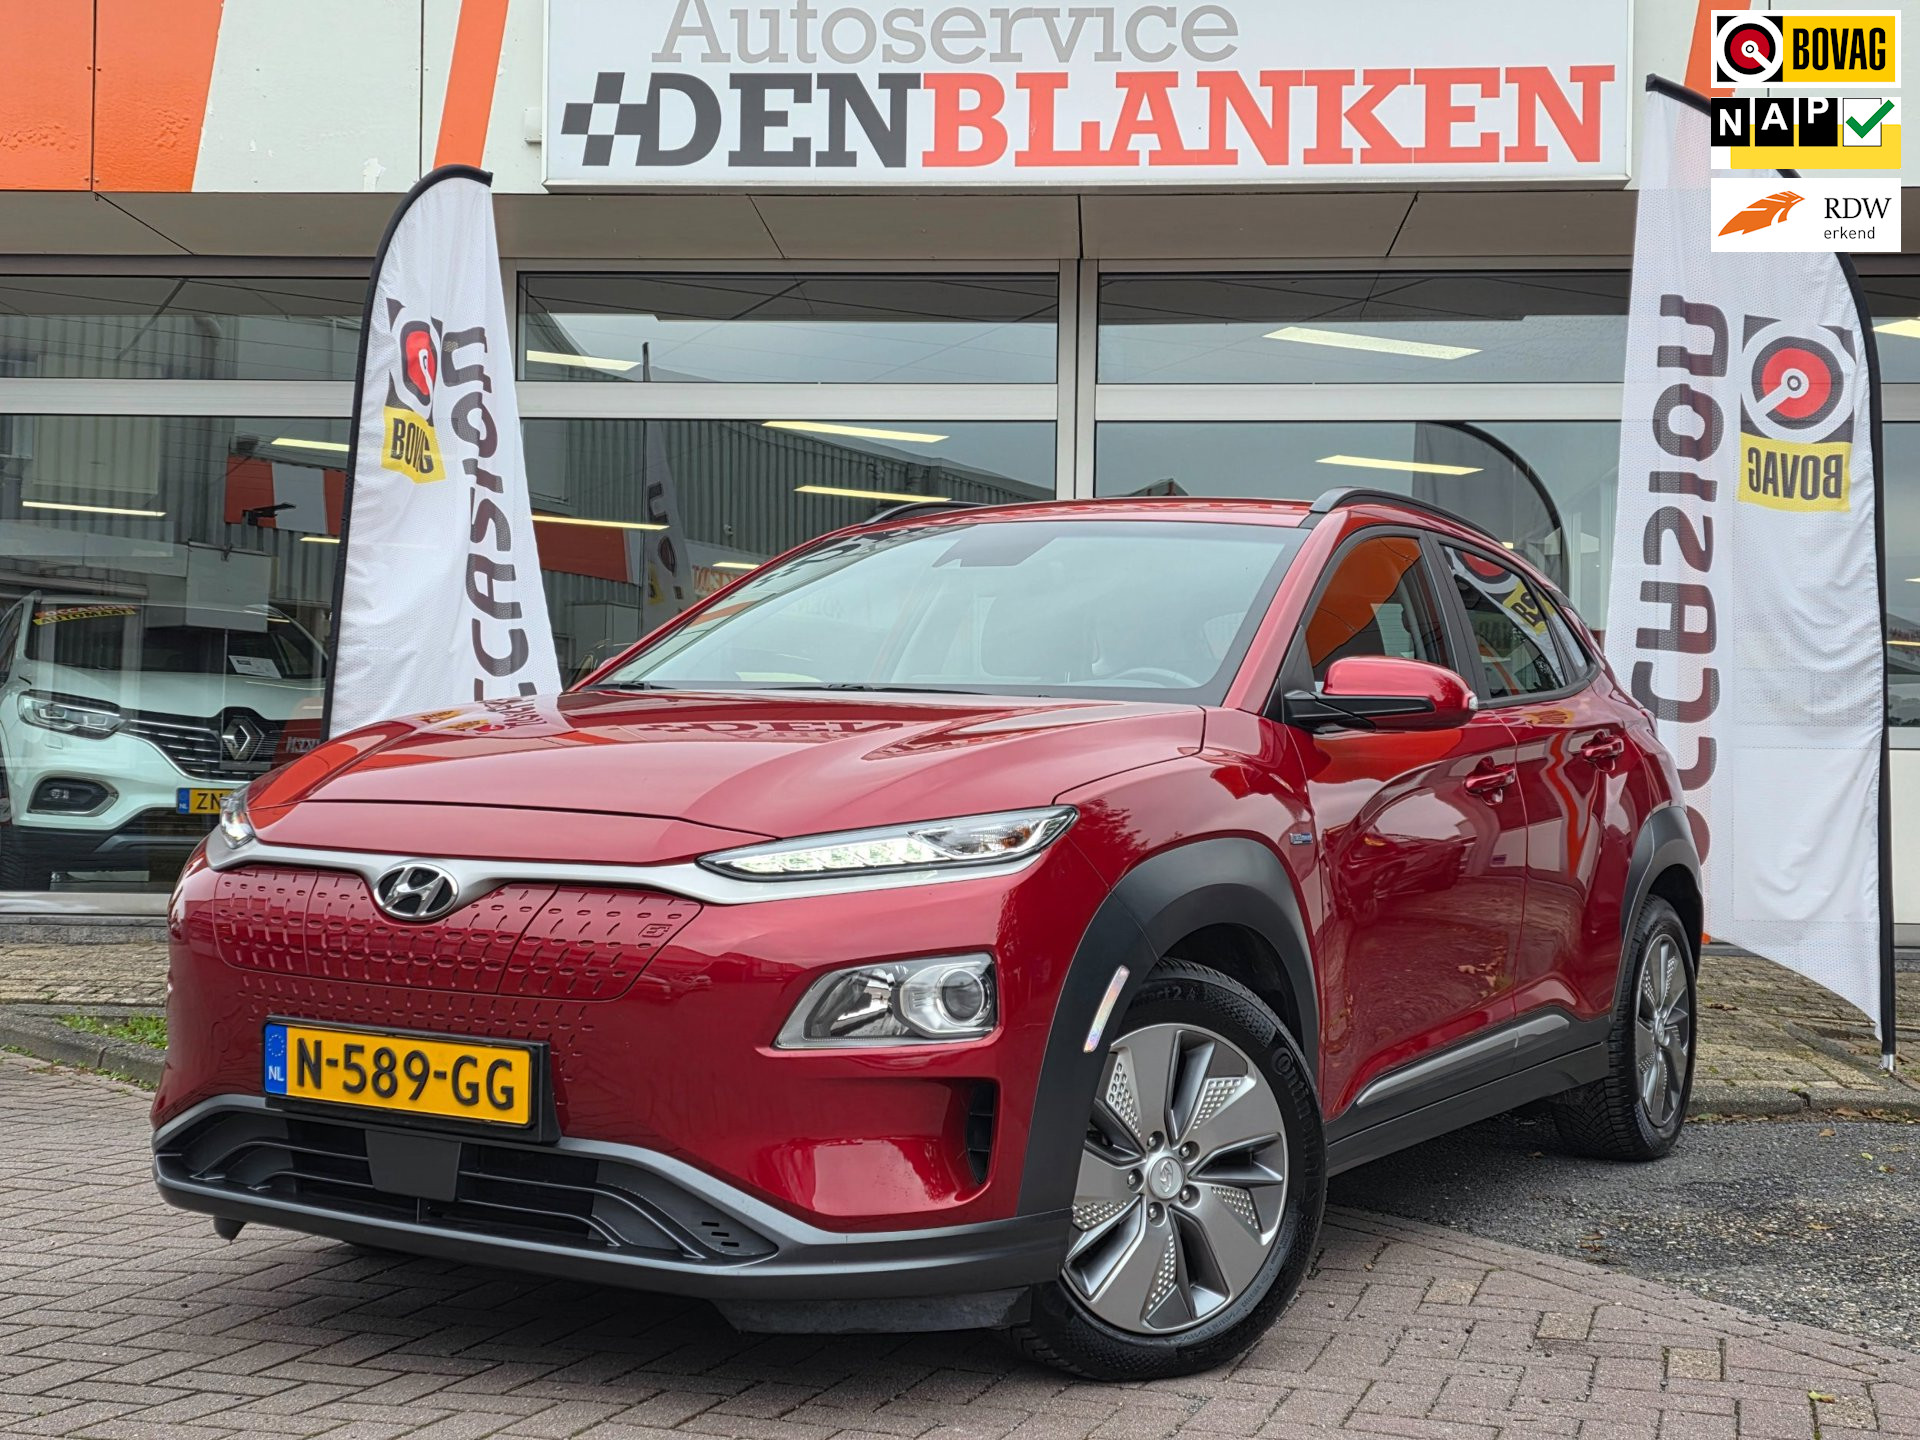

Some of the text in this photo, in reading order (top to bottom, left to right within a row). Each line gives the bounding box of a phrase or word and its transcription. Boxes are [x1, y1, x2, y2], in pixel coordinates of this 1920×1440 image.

[651, 0, 1239, 63] Autoservice
[268, 1065, 285, 1082] NL
[295, 1037, 515, 1110] N-589-GG
